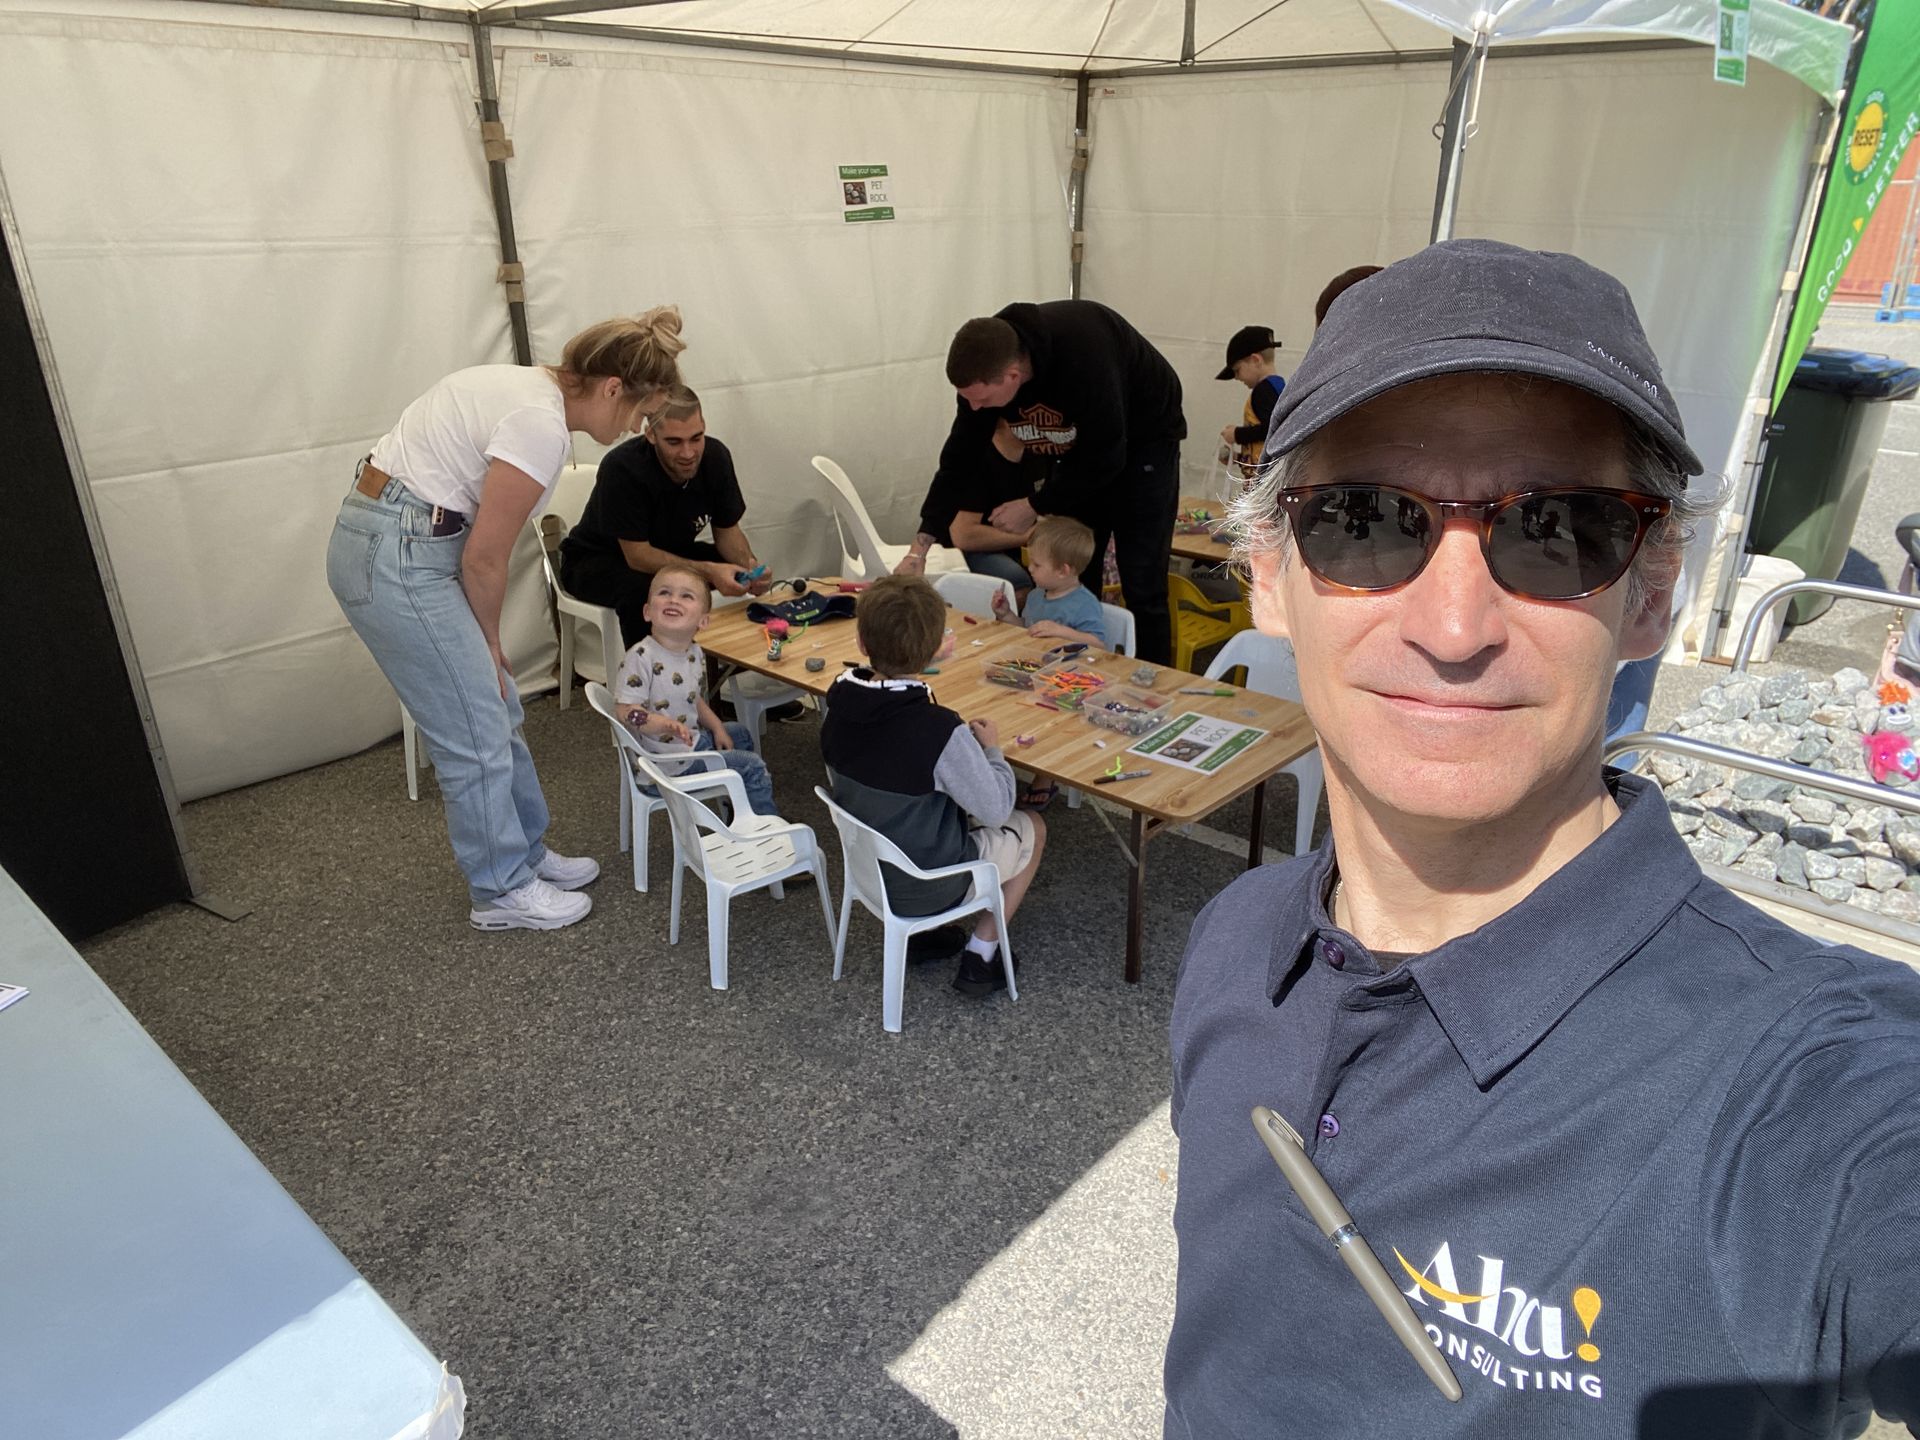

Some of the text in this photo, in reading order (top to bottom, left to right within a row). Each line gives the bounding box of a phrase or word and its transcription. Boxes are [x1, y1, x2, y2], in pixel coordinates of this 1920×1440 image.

[1853, 128, 1880, 146] RESET
[857, 168, 869, 176] your
[870, 180, 882, 190] PET
[869, 193, 889, 203] ROCK
[1817, 237, 1852, 303] GOOD
[1866, 111, 1920, 212] BETTER
[1190, 724, 1210, 736] PET
[1204, 727, 1234, 743] ROCK
[1403, 1240, 1602, 1363] Aha!
[1425, 1323, 1603, 1399] ONSULTING
